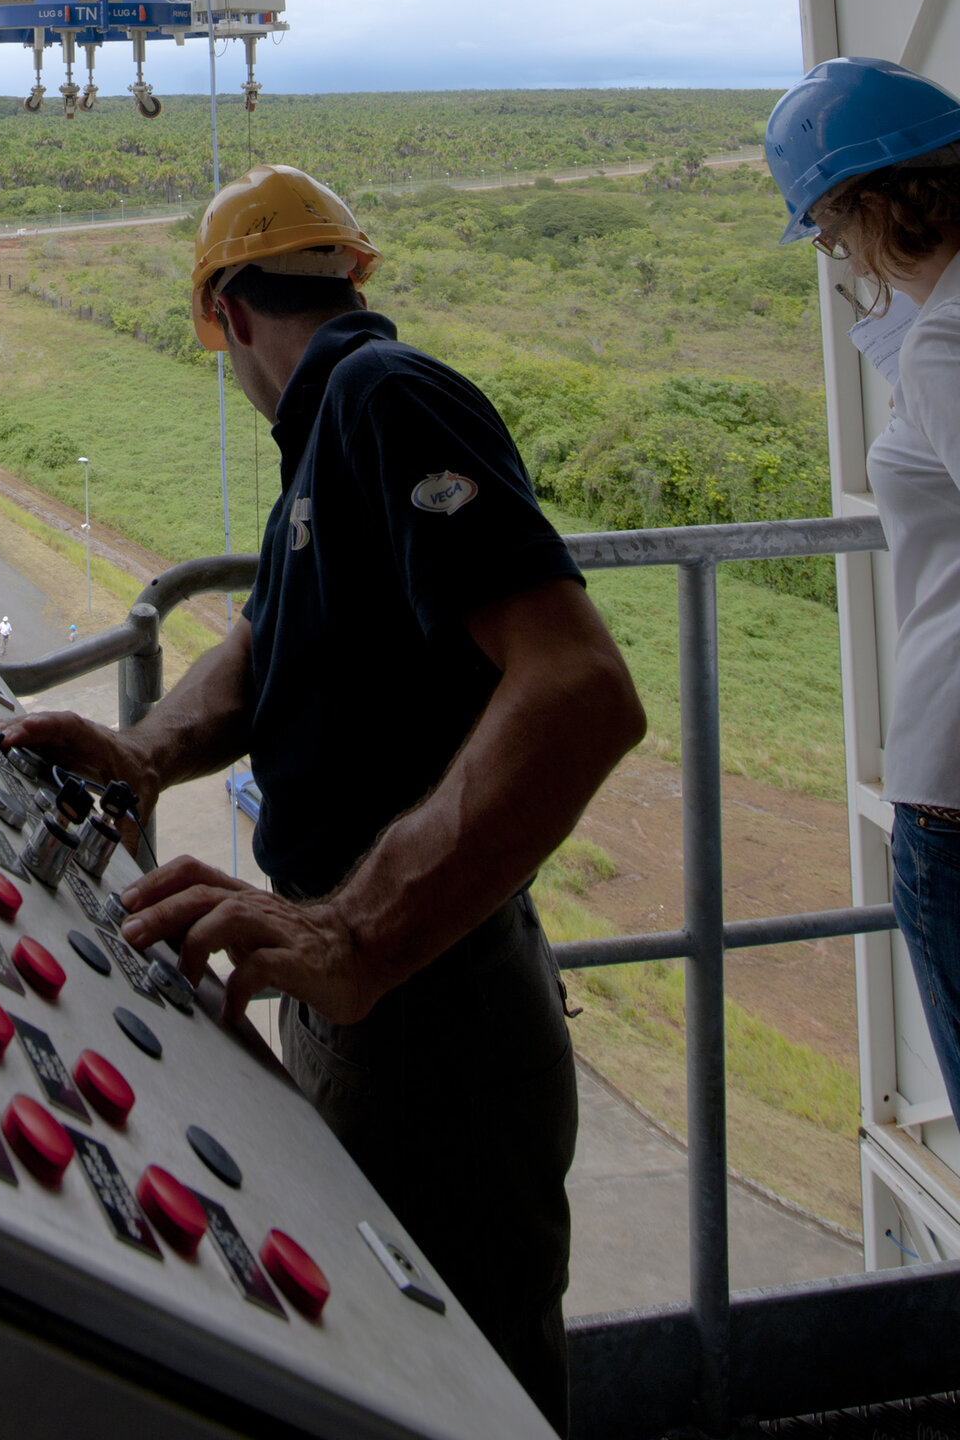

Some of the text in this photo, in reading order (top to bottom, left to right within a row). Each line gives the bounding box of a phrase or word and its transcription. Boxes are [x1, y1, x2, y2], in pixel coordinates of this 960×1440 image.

[38, 9, 63, 18] LUG 8
[75, 6, 97, 21] TN
[113, 8, 137, 17] LUG 4
[172, 9, 189, 18] RING
[429, 482, 463, 505] VEGA
